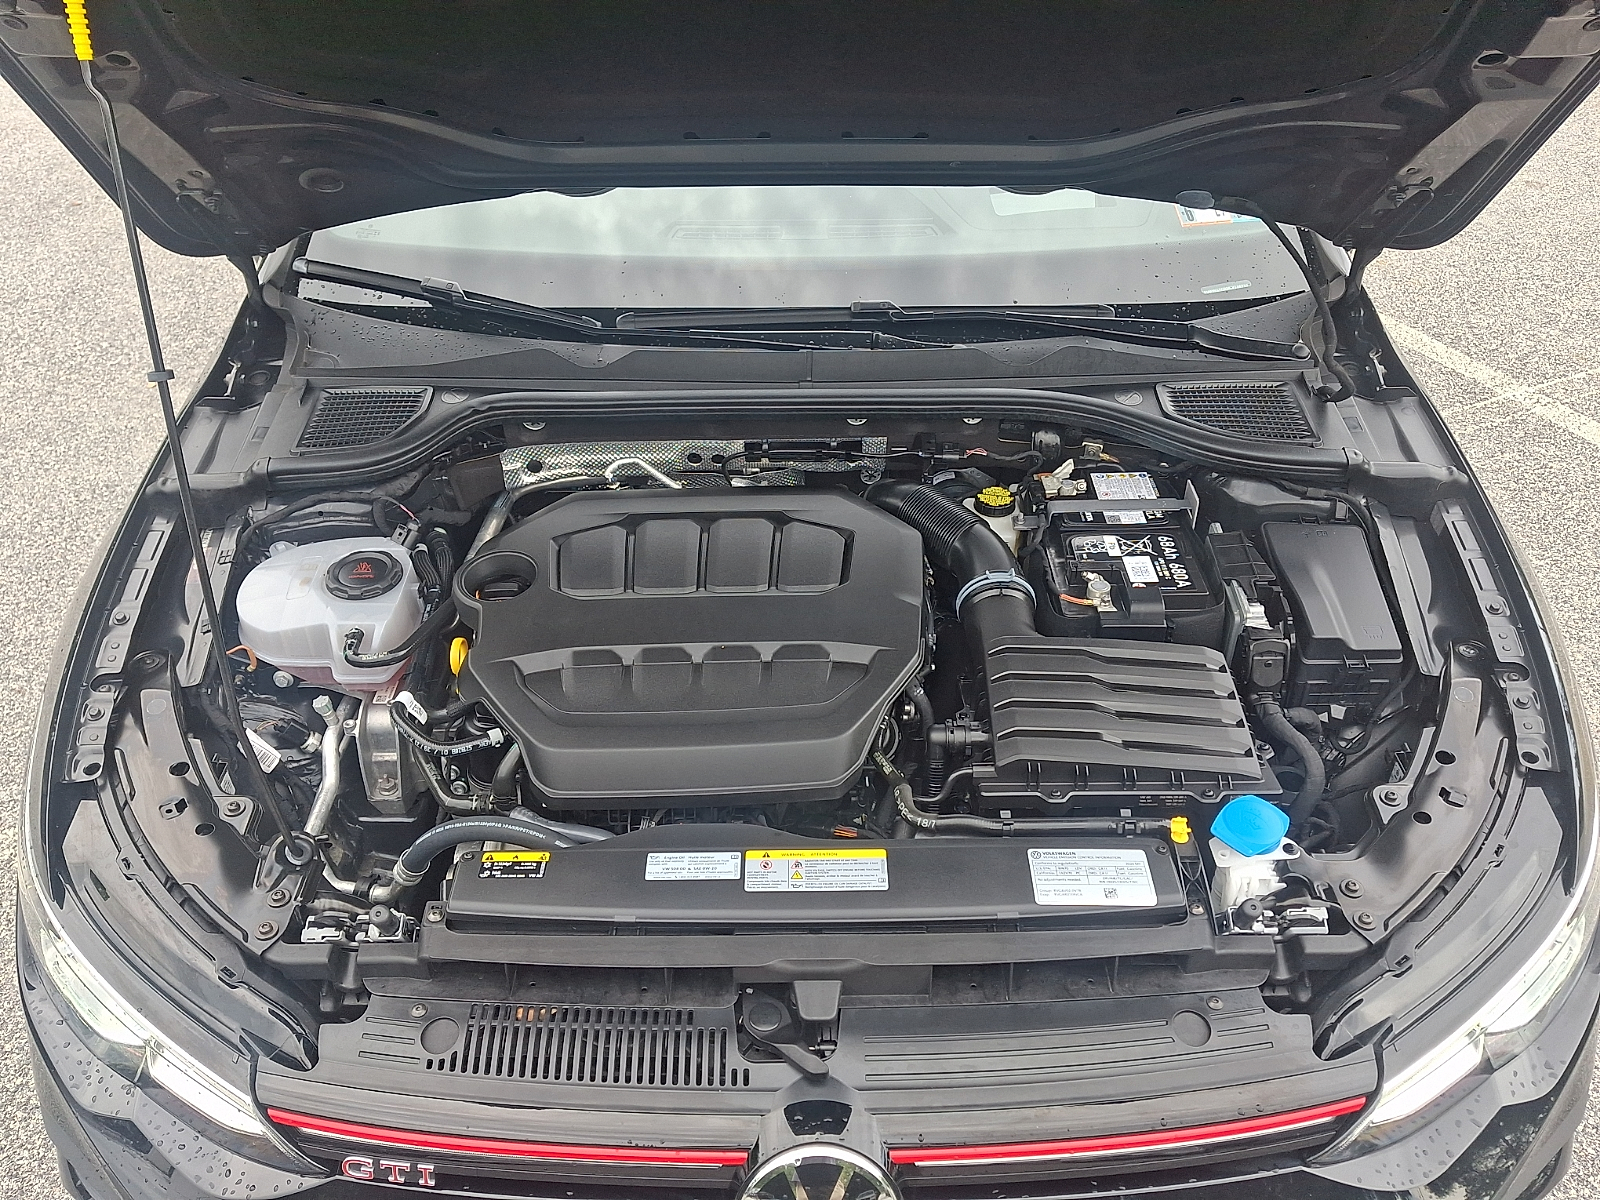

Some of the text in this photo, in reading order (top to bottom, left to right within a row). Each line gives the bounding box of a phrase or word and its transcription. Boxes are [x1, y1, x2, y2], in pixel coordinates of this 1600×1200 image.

[1157, 535, 1180, 560] 68Ah
[1168, 562, 1192, 588] 680A
[341, 1155, 436, 1187] GTI
